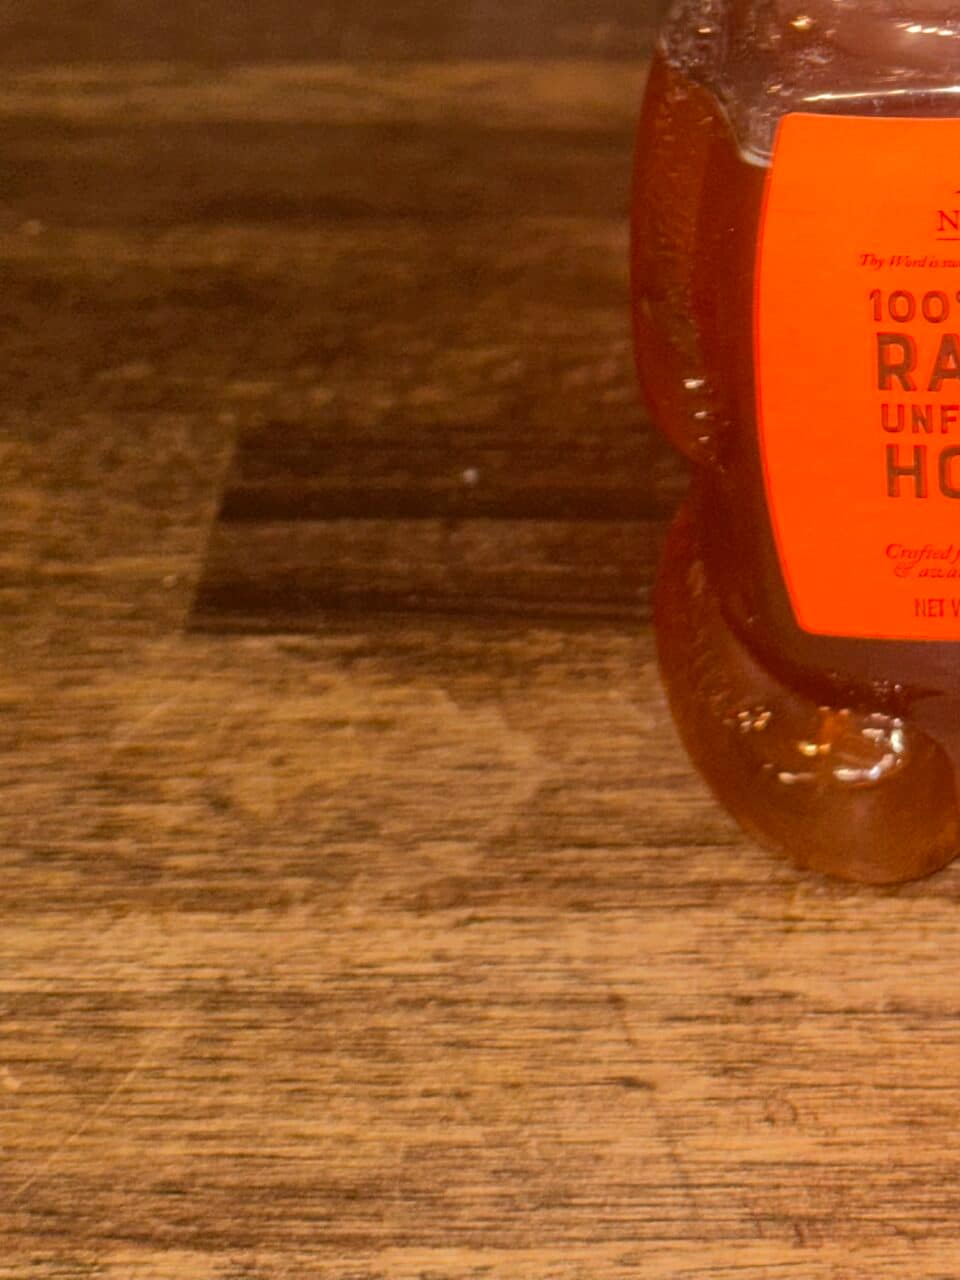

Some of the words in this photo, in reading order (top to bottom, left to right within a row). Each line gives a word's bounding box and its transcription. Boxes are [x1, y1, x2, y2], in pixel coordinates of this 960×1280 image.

[860, 253, 883, 270] Thy
[889, 253, 928, 269] Word
[928, 256, 939, 268] is
[885, 543, 953, 565] Crafted
[913, 597, 946, 618] NET
